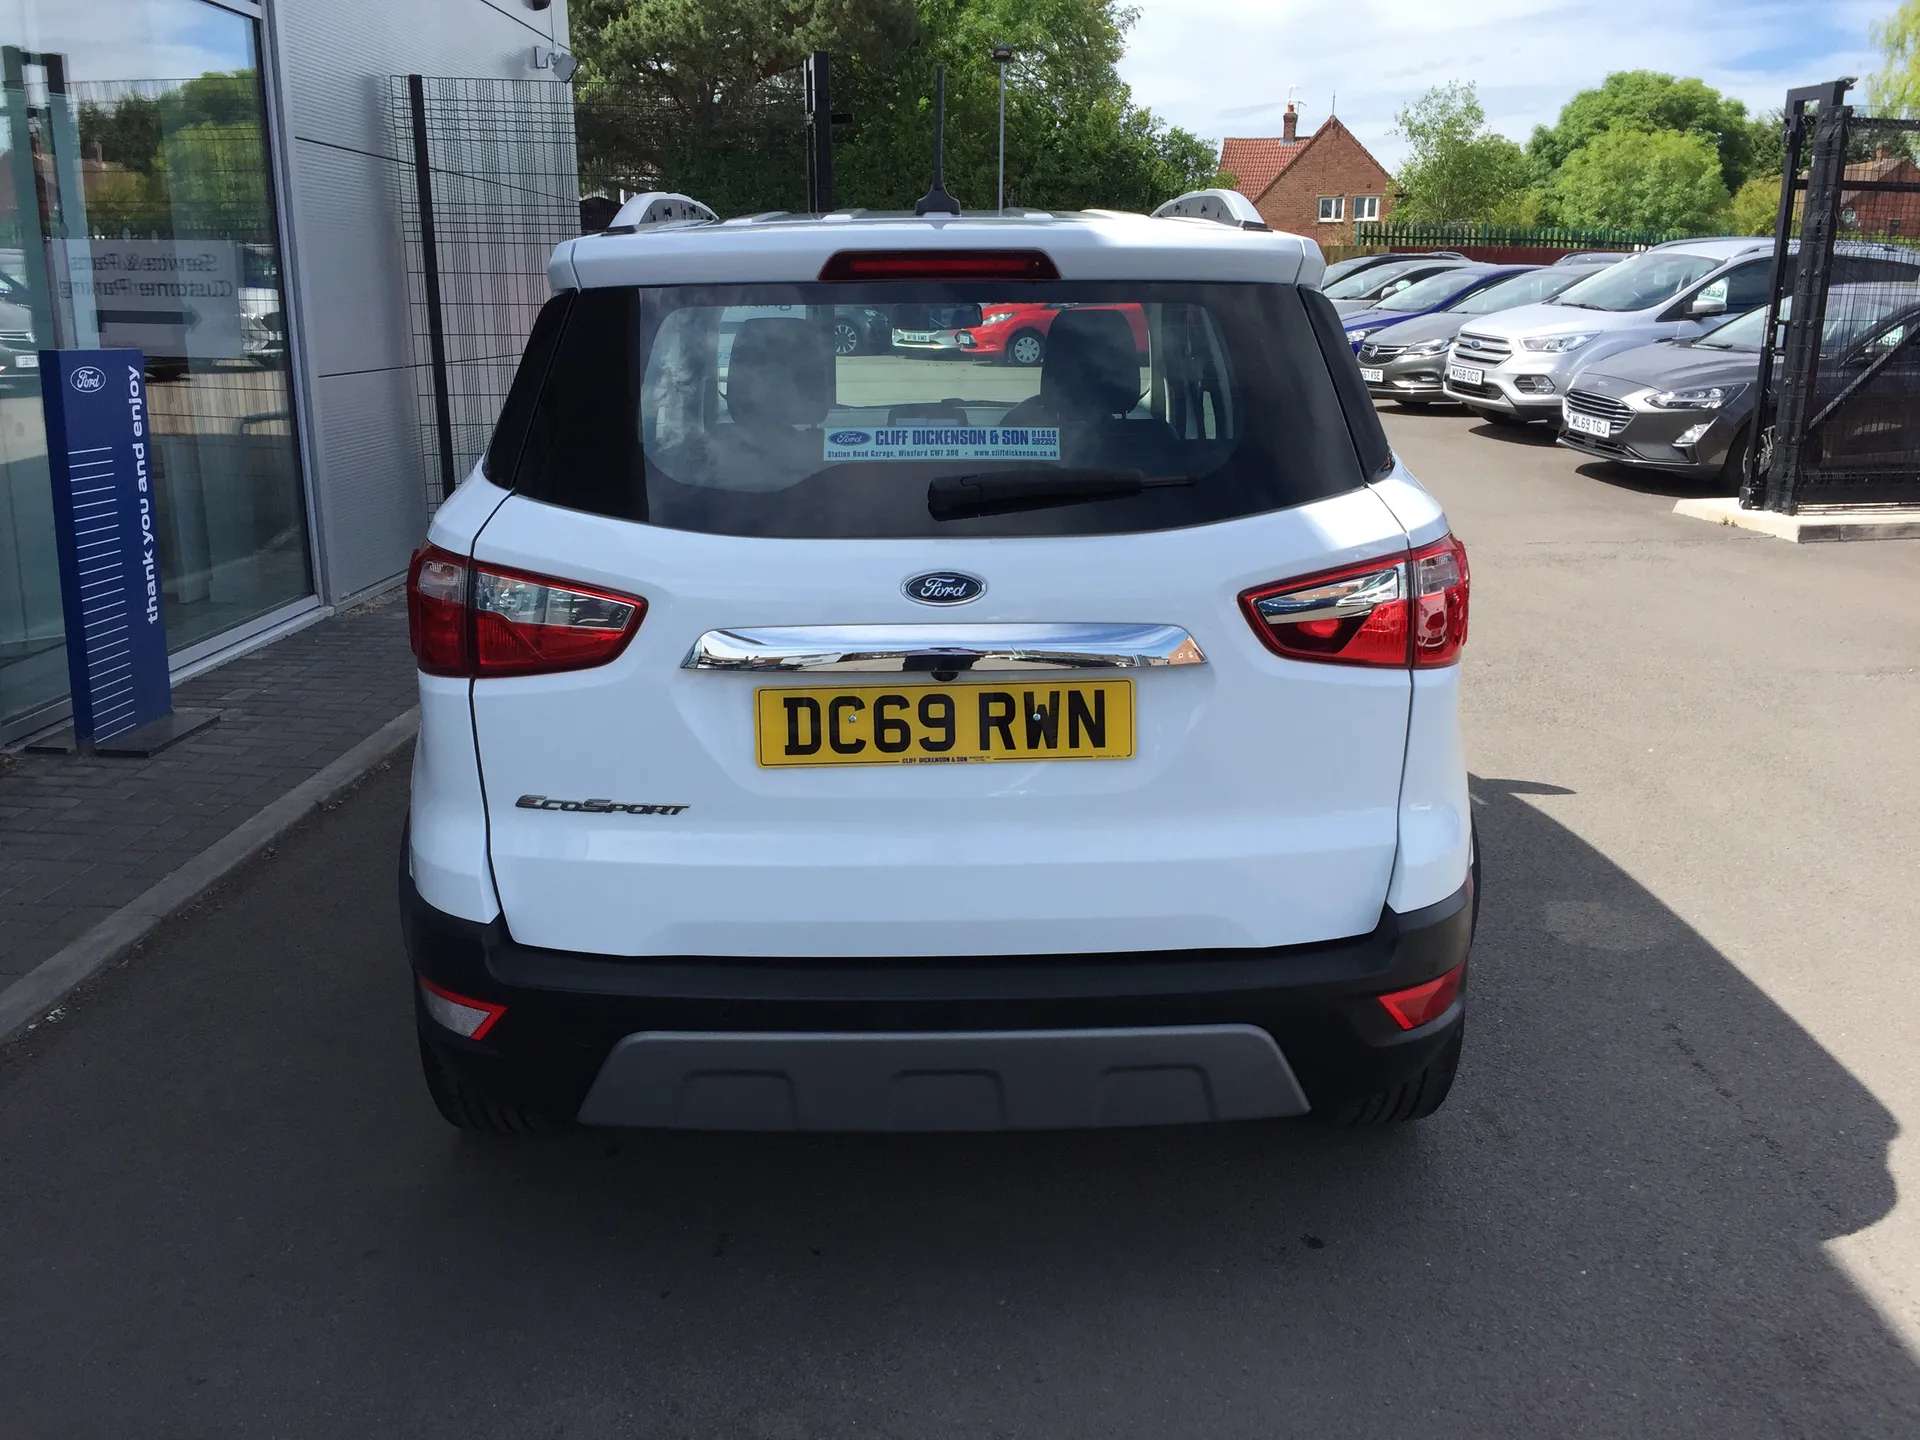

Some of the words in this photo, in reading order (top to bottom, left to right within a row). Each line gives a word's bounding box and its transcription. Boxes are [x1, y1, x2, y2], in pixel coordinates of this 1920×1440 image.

[77, 369, 100, 388] Ford
[128, 365, 142, 437] enjoy
[828, 450, 851, 458] Station
[853, 450, 869, 458] Road
[899, 449, 928, 457] Winsford
[875, 430, 909, 445] CLIFF
[912, 430, 987, 445] DICKENSON
[989, 430, 1000, 445] &
[1001, 430, 1029, 445] SON
[132, 443, 148, 492] and
[140, 498, 154, 545] you
[142, 549, 158, 624] thank
[920, 577, 967, 597] Ford
[782, 693, 956, 756] DC69
[978, 689, 1106, 751] RWN
